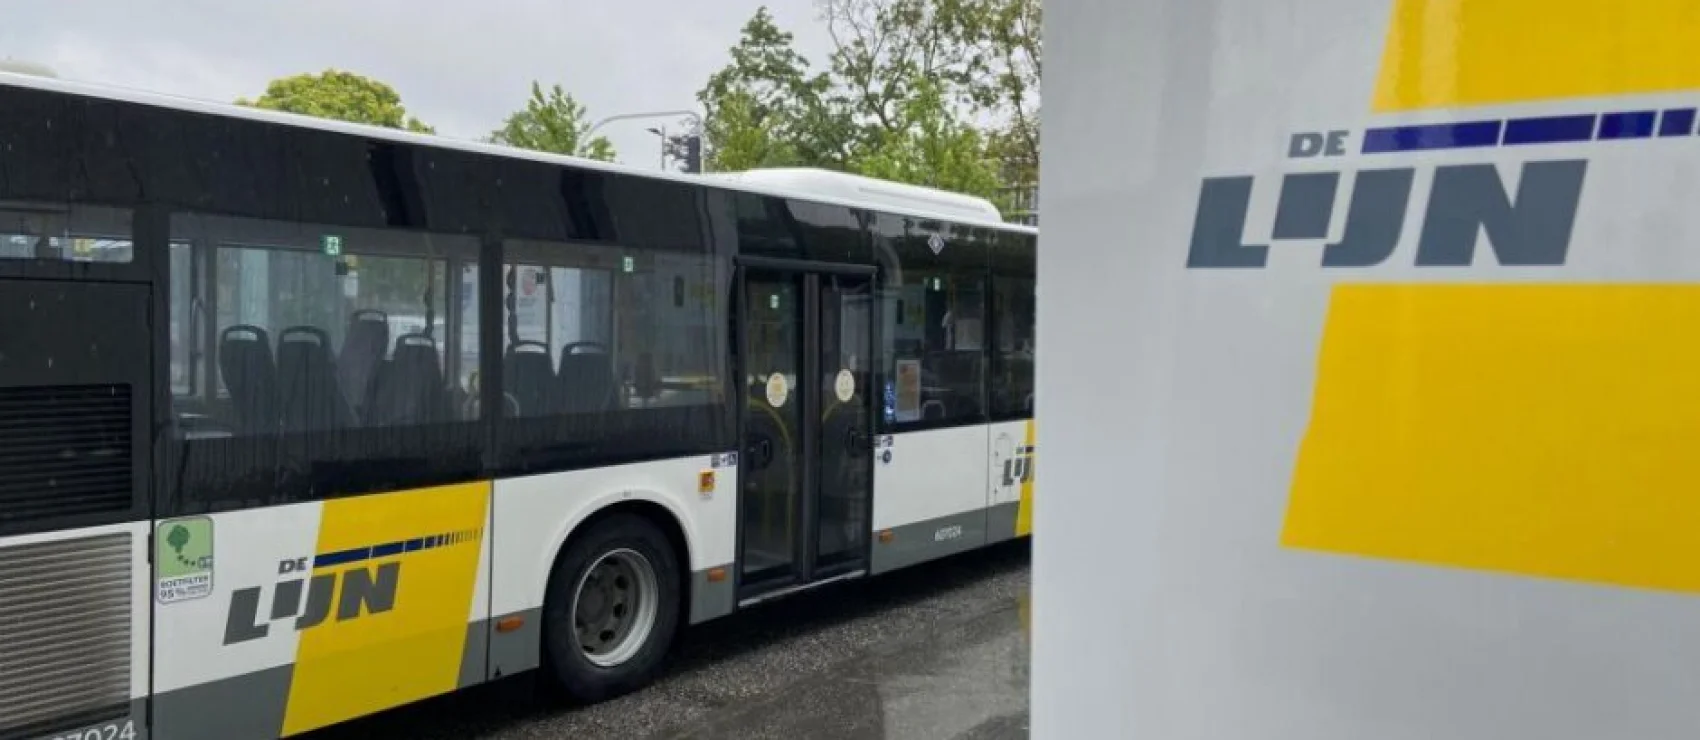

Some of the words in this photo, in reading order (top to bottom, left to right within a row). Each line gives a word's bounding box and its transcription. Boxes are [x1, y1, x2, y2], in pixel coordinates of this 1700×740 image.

[1288, 130, 1349, 158] DE
[1186, 159, 1588, 269] LIJN
[1002, 457, 1035, 487] LIJ
[278, 557, 307, 574] DE
[223, 561, 400, 646] LIJN
[53, 720, 137, 740] 024
